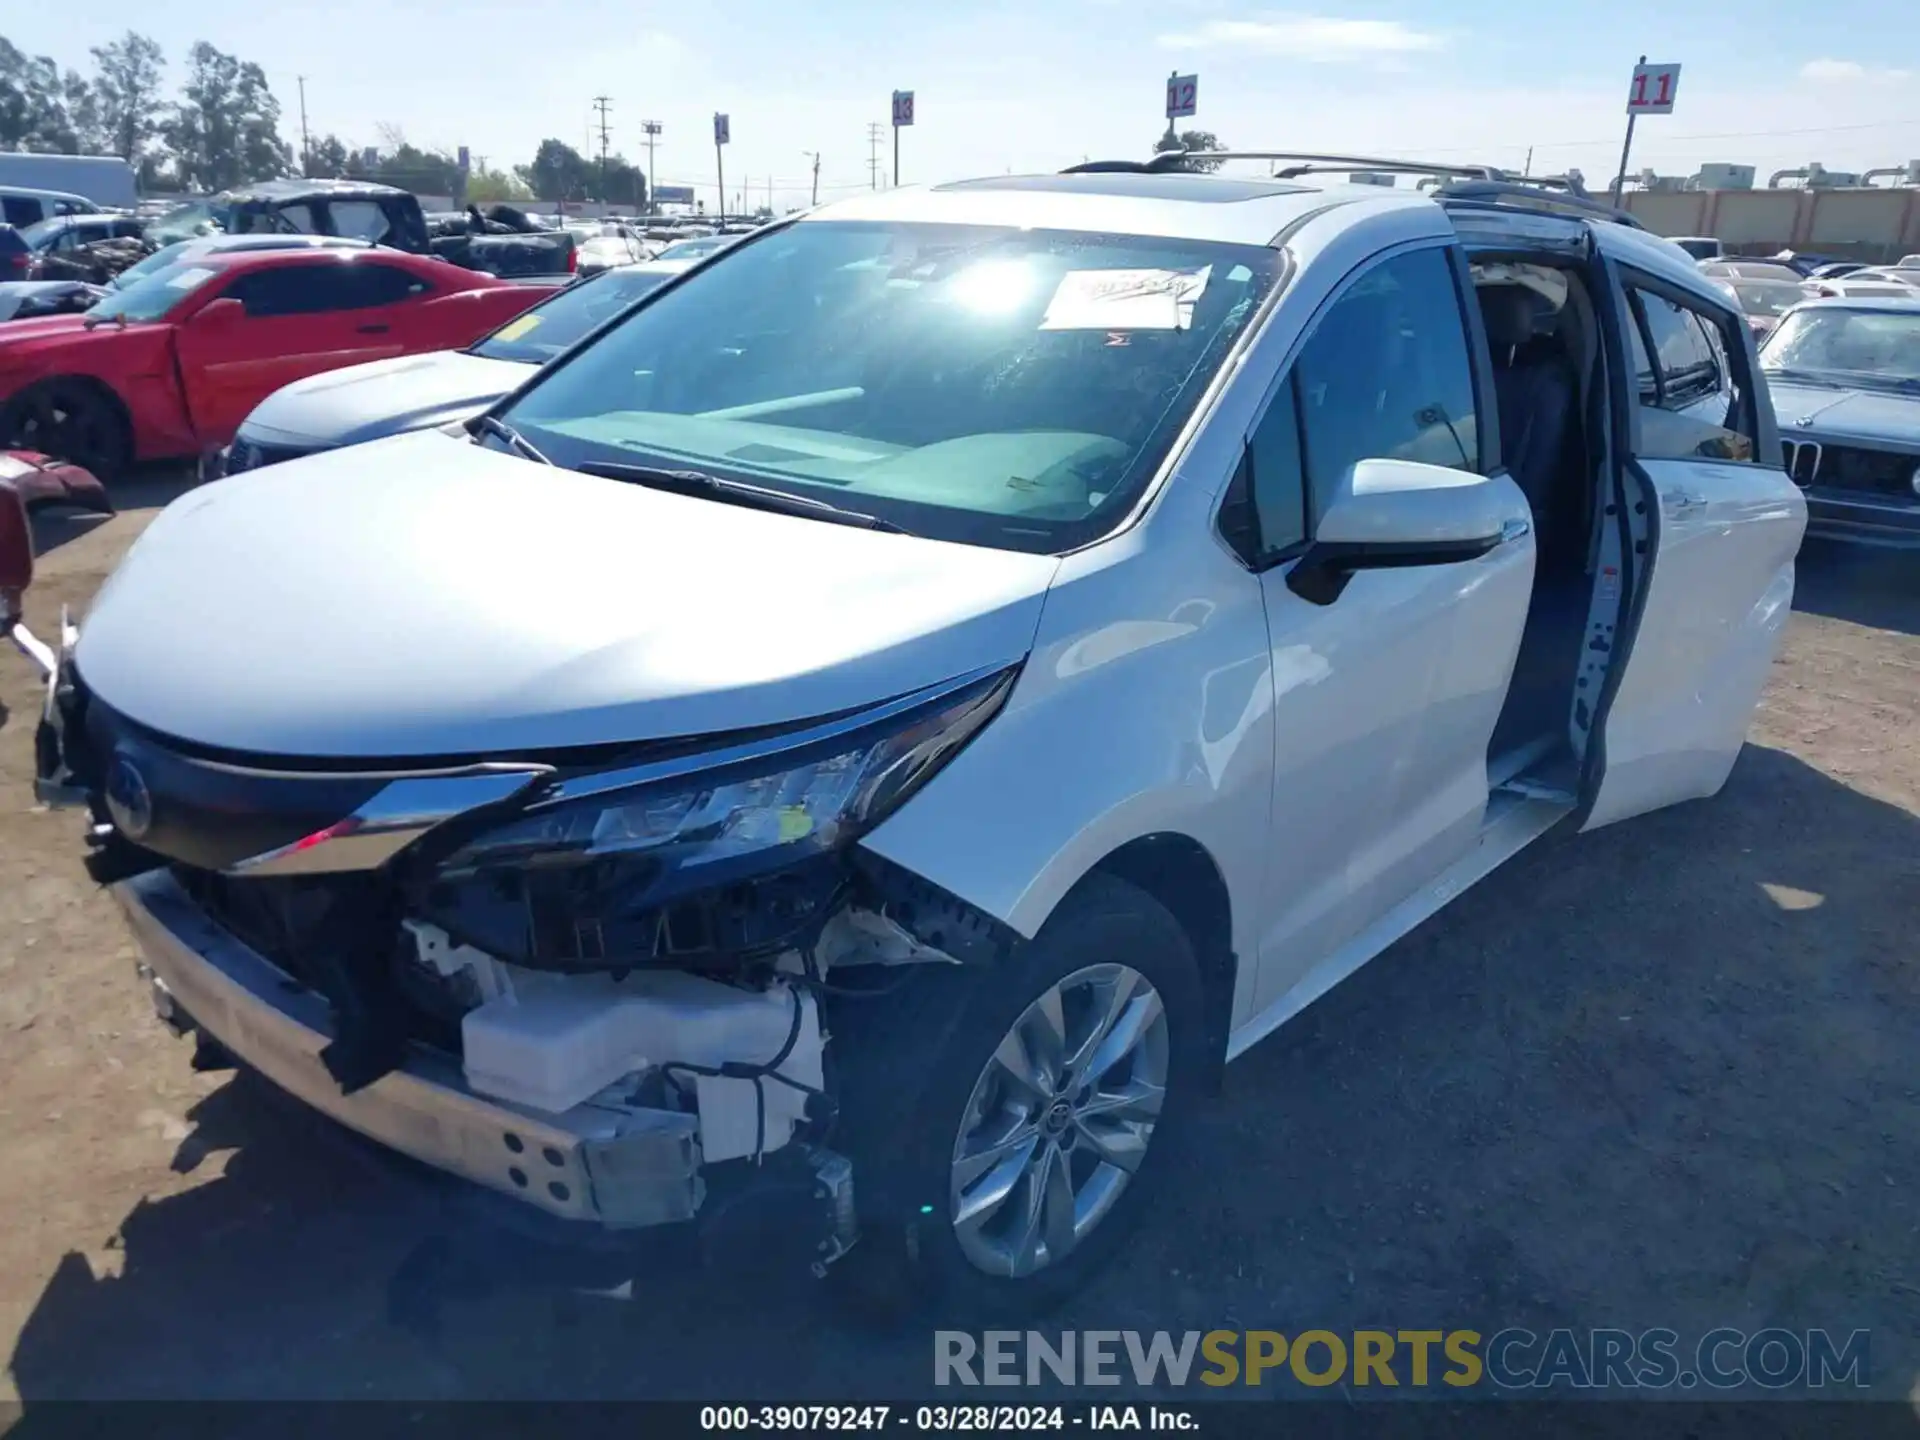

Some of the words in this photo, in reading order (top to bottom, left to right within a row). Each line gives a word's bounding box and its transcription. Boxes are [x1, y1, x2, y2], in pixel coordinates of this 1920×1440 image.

[1167, 83, 1195, 111] 12
[1630, 72, 1671, 106] 11
[894, 97, 913, 120] 13
